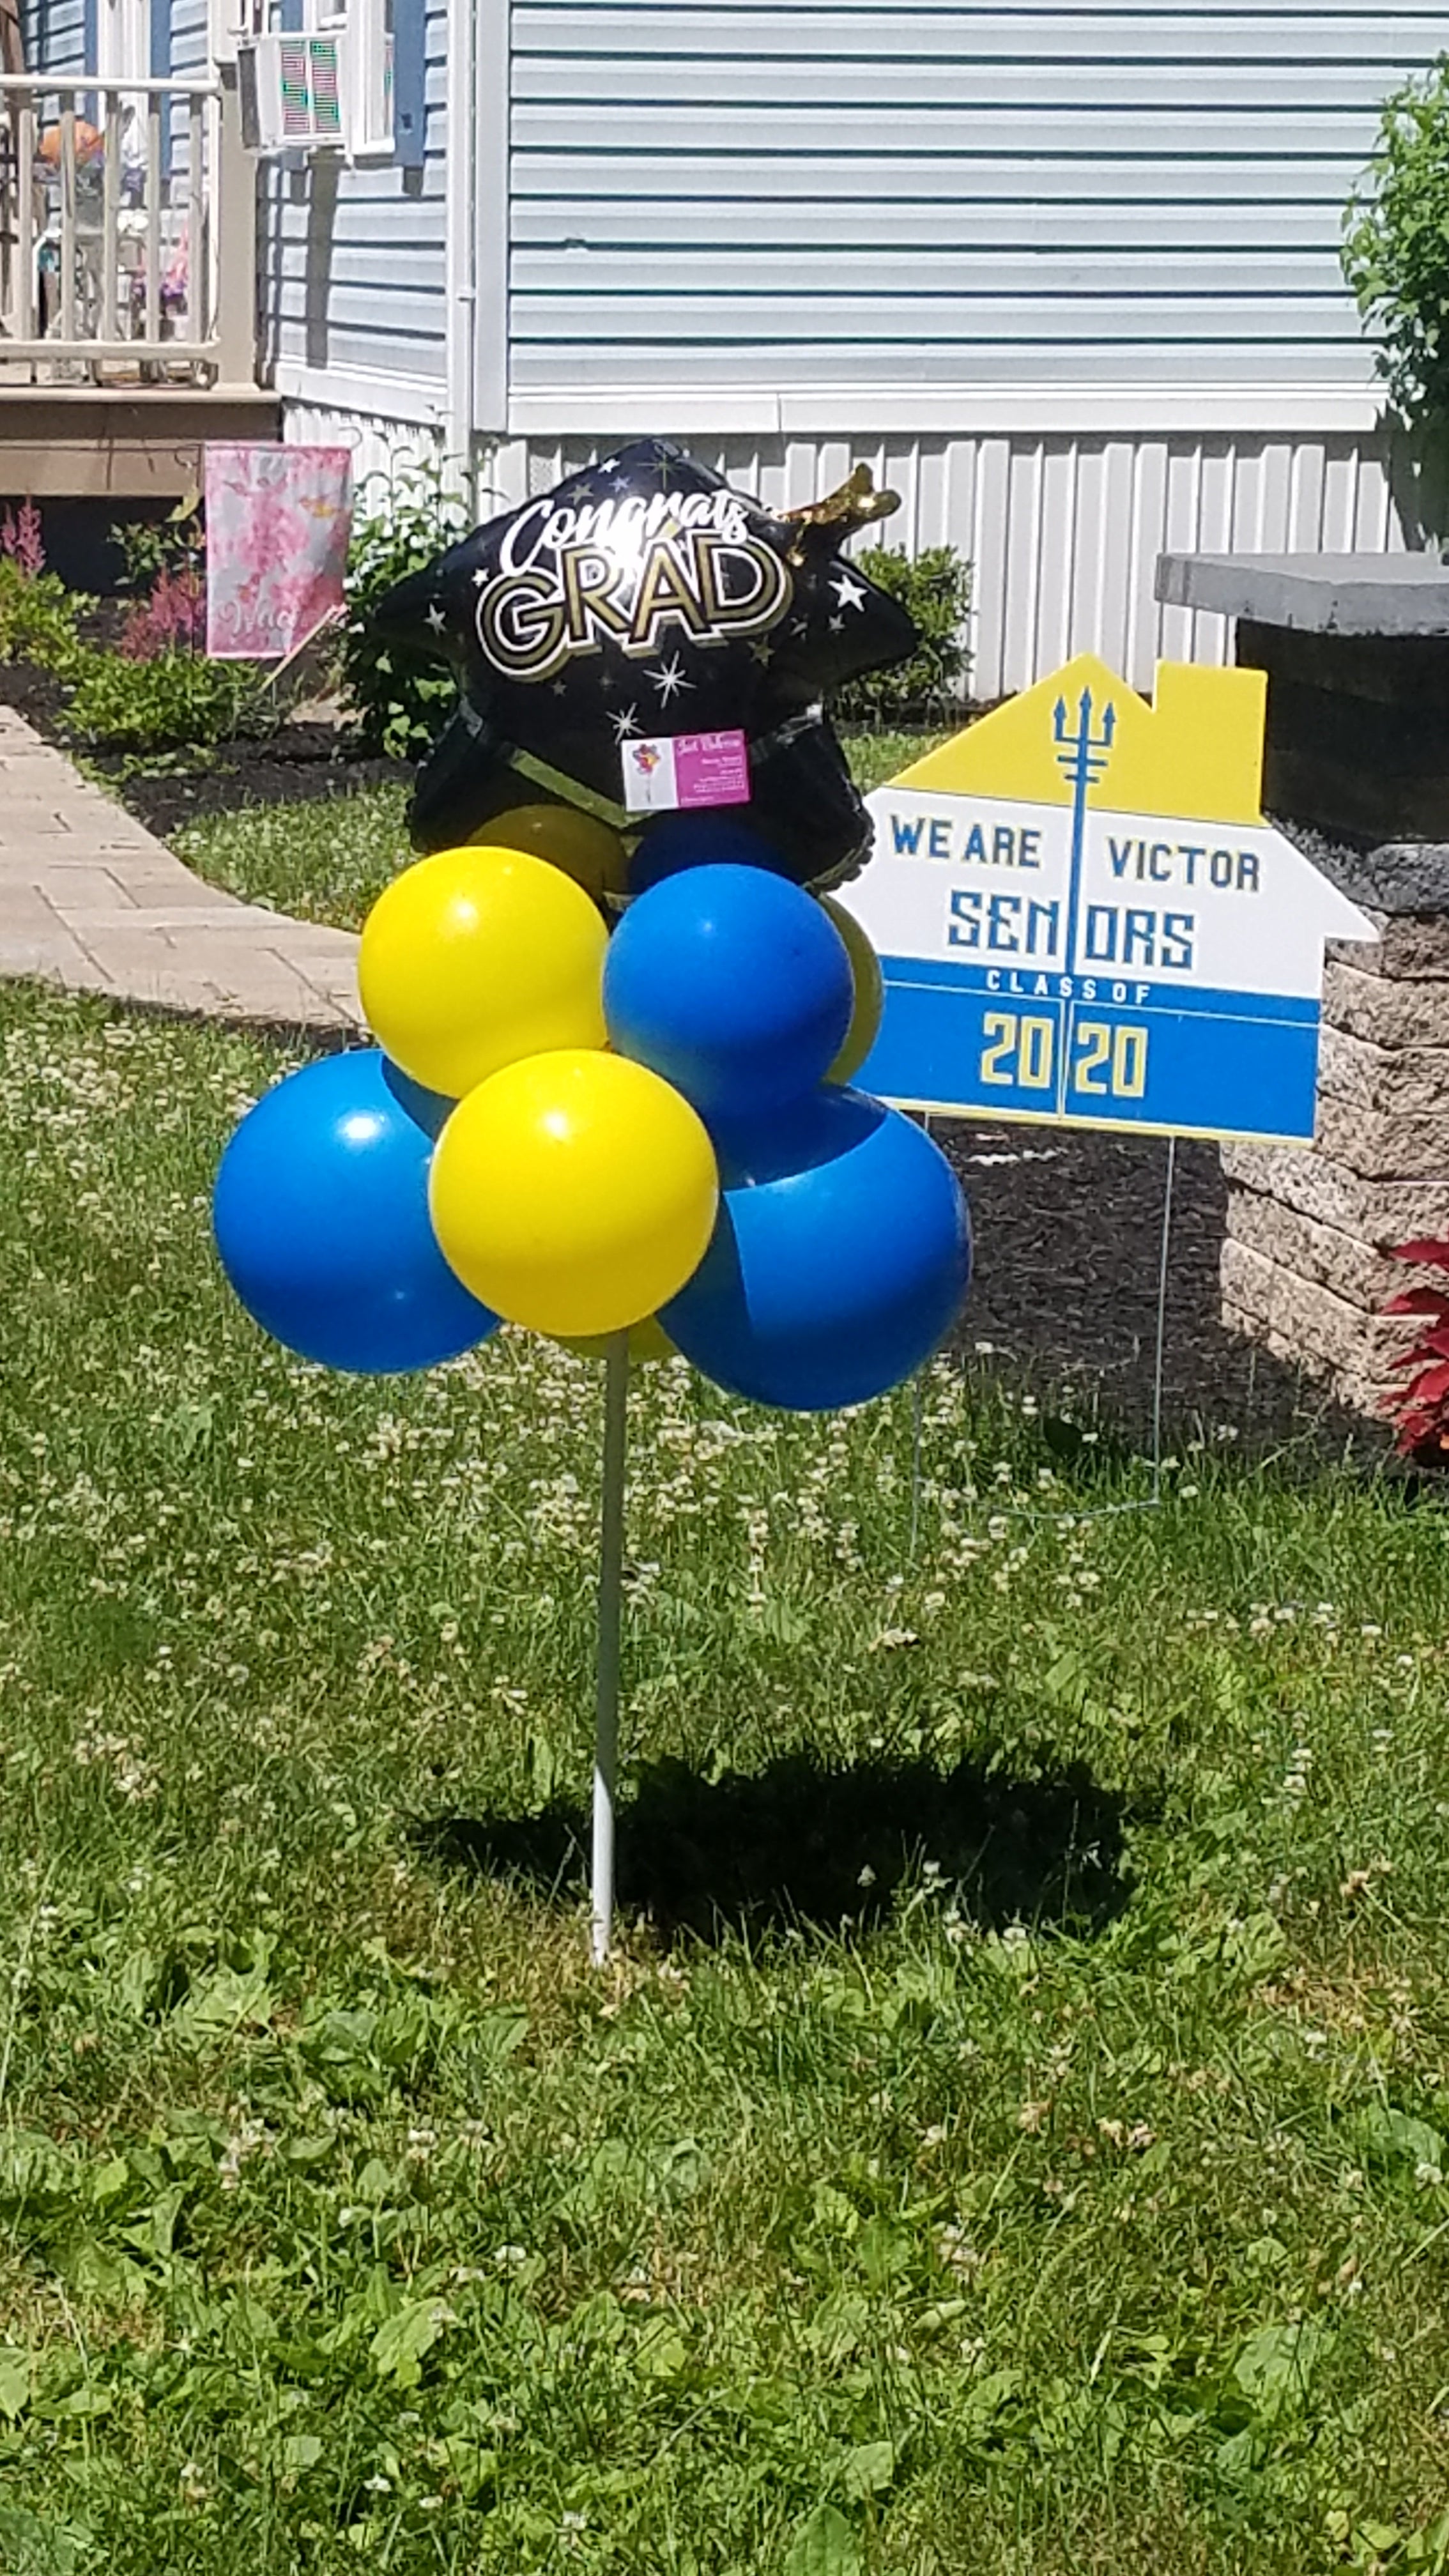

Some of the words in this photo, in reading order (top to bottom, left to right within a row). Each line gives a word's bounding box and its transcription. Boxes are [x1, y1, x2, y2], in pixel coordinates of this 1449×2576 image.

[500, 491, 749, 576] Congrats
[476, 530, 793, 682] GRAD
[891, 815, 953, 858] WE
[962, 824, 1041, 868] ARE
[1108, 836, 1260, 893] VICTOR
[986, 969, 1096, 1000] CLASS
[1112, 983, 1151, 1004] OF
